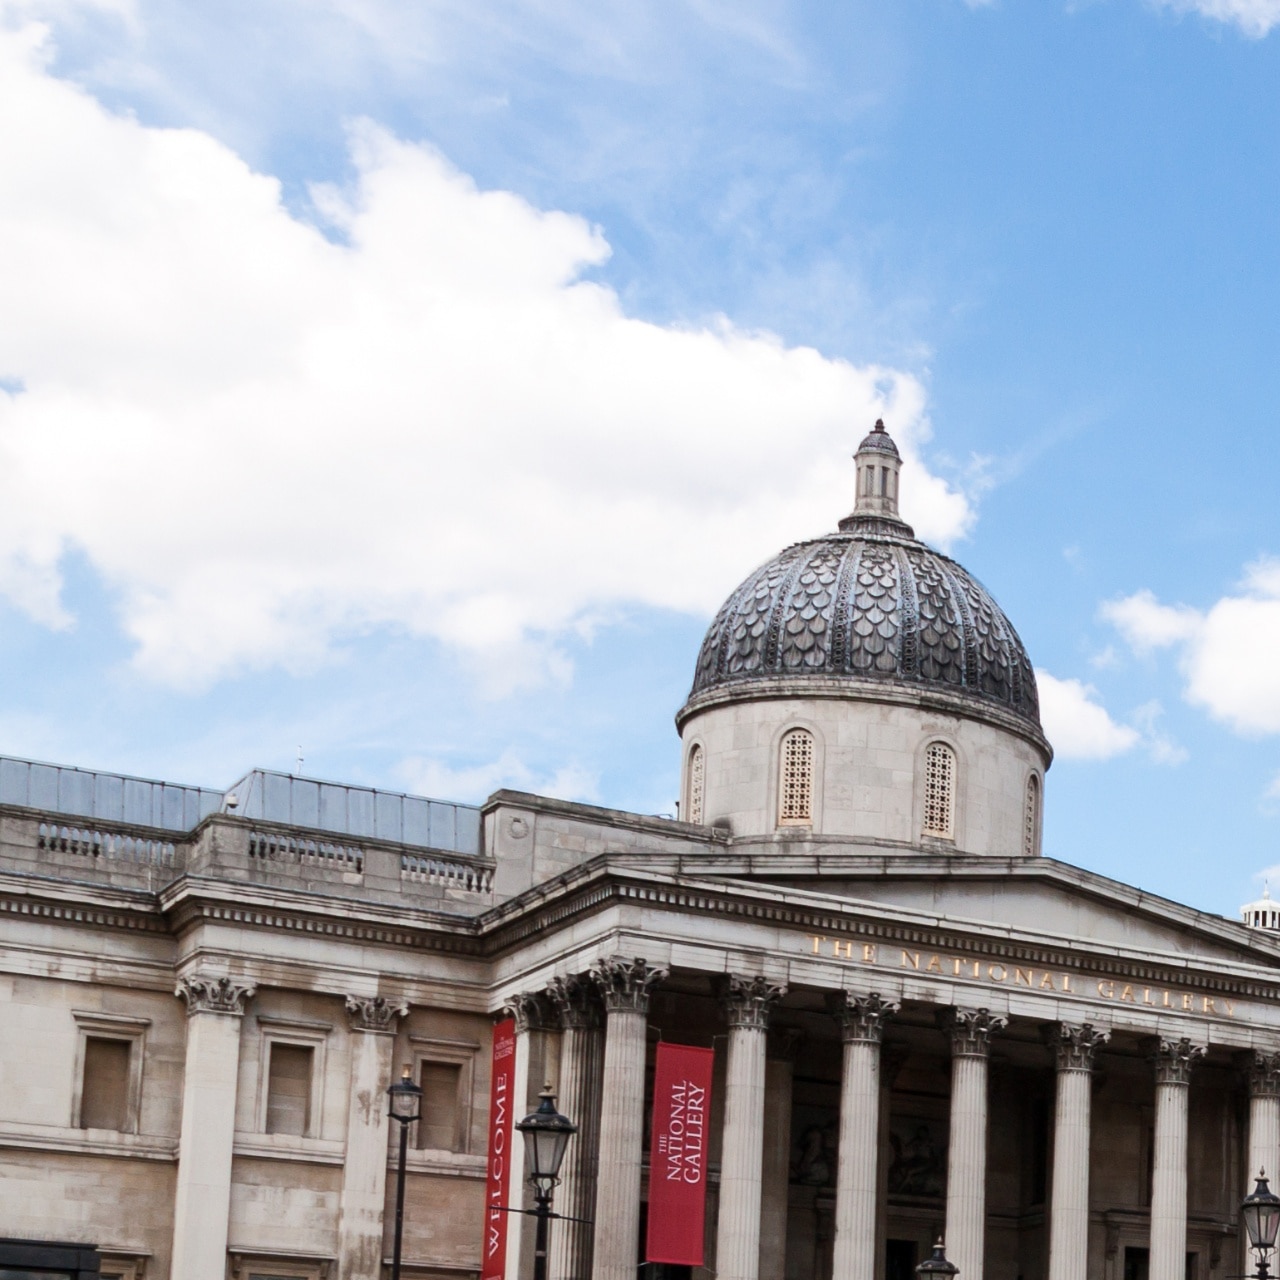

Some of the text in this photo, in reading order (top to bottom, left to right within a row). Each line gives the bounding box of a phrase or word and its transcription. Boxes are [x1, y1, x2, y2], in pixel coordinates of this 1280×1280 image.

[806, 934, 1236, 1018] THE NATIONAL GALLERY
[489, 1072, 507, 1259] WELCOME
[659, 1133, 667, 1153] THE
[667, 1080, 686, 1181] NATIONAL
[683, 1082, 705, 1184] GALLERY
